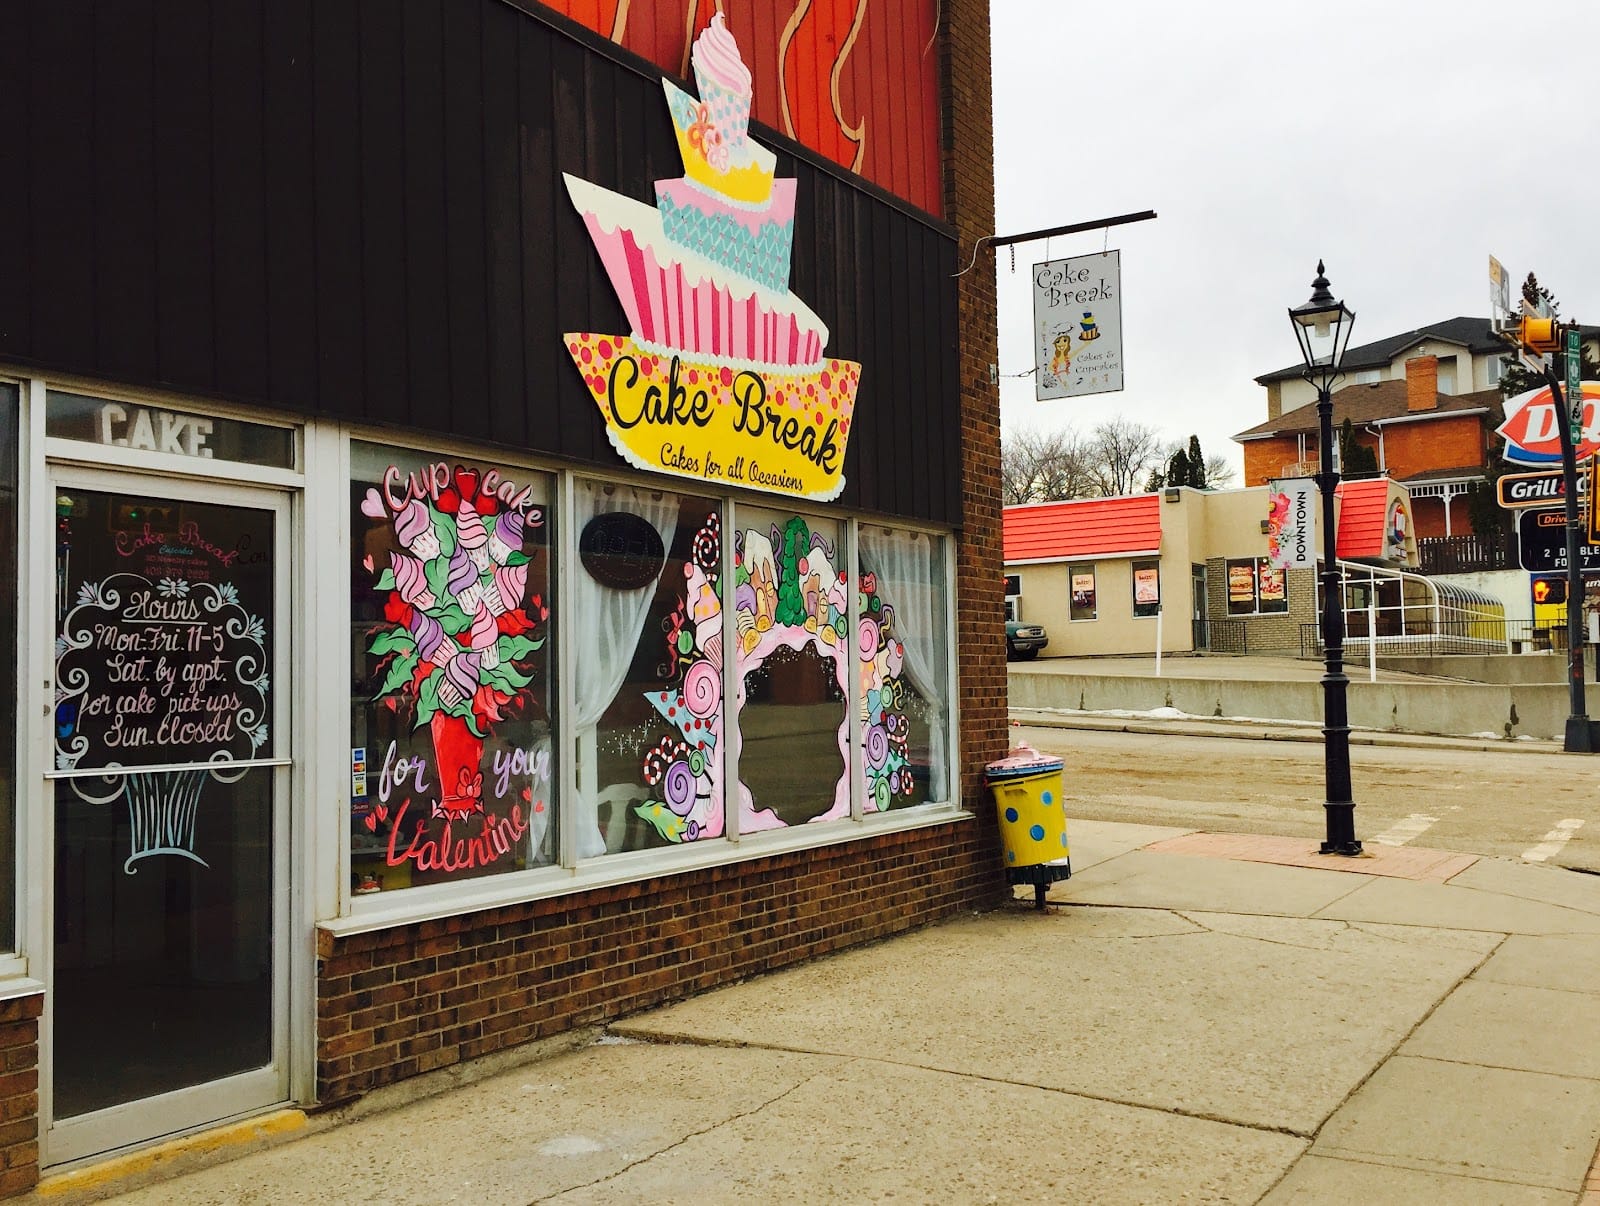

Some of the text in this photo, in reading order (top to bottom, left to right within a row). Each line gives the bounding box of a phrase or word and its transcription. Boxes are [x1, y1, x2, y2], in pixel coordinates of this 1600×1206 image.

[1036, 264, 1090, 289] Cake
[1044, 278, 1113, 308] Break
[1076, 353, 1103, 363] Cakes
[101, 403, 213, 459] CAKE
[608, 355, 838, 475] Cake Break
[660, 443, 803, 491] Cakes for all Occasions
[115, 522, 165, 557] Cake
[179, 521, 239, 568] Break
[1296, 491, 1307, 562] DOWNTOWN
[1544, 548, 1551, 558] 2
[1583, 557, 1590, 566] 7
[122, 590, 202, 620] Hours
[187, 625, 224, 652] 11-5
[106, 653, 232, 697] Sat. by appt.
[76, 686, 242, 733] for cake pick-ups
[104, 714, 154, 747] Sun.
[378, 739, 552, 802] for your
[386, 797, 532, 872] Valentine
